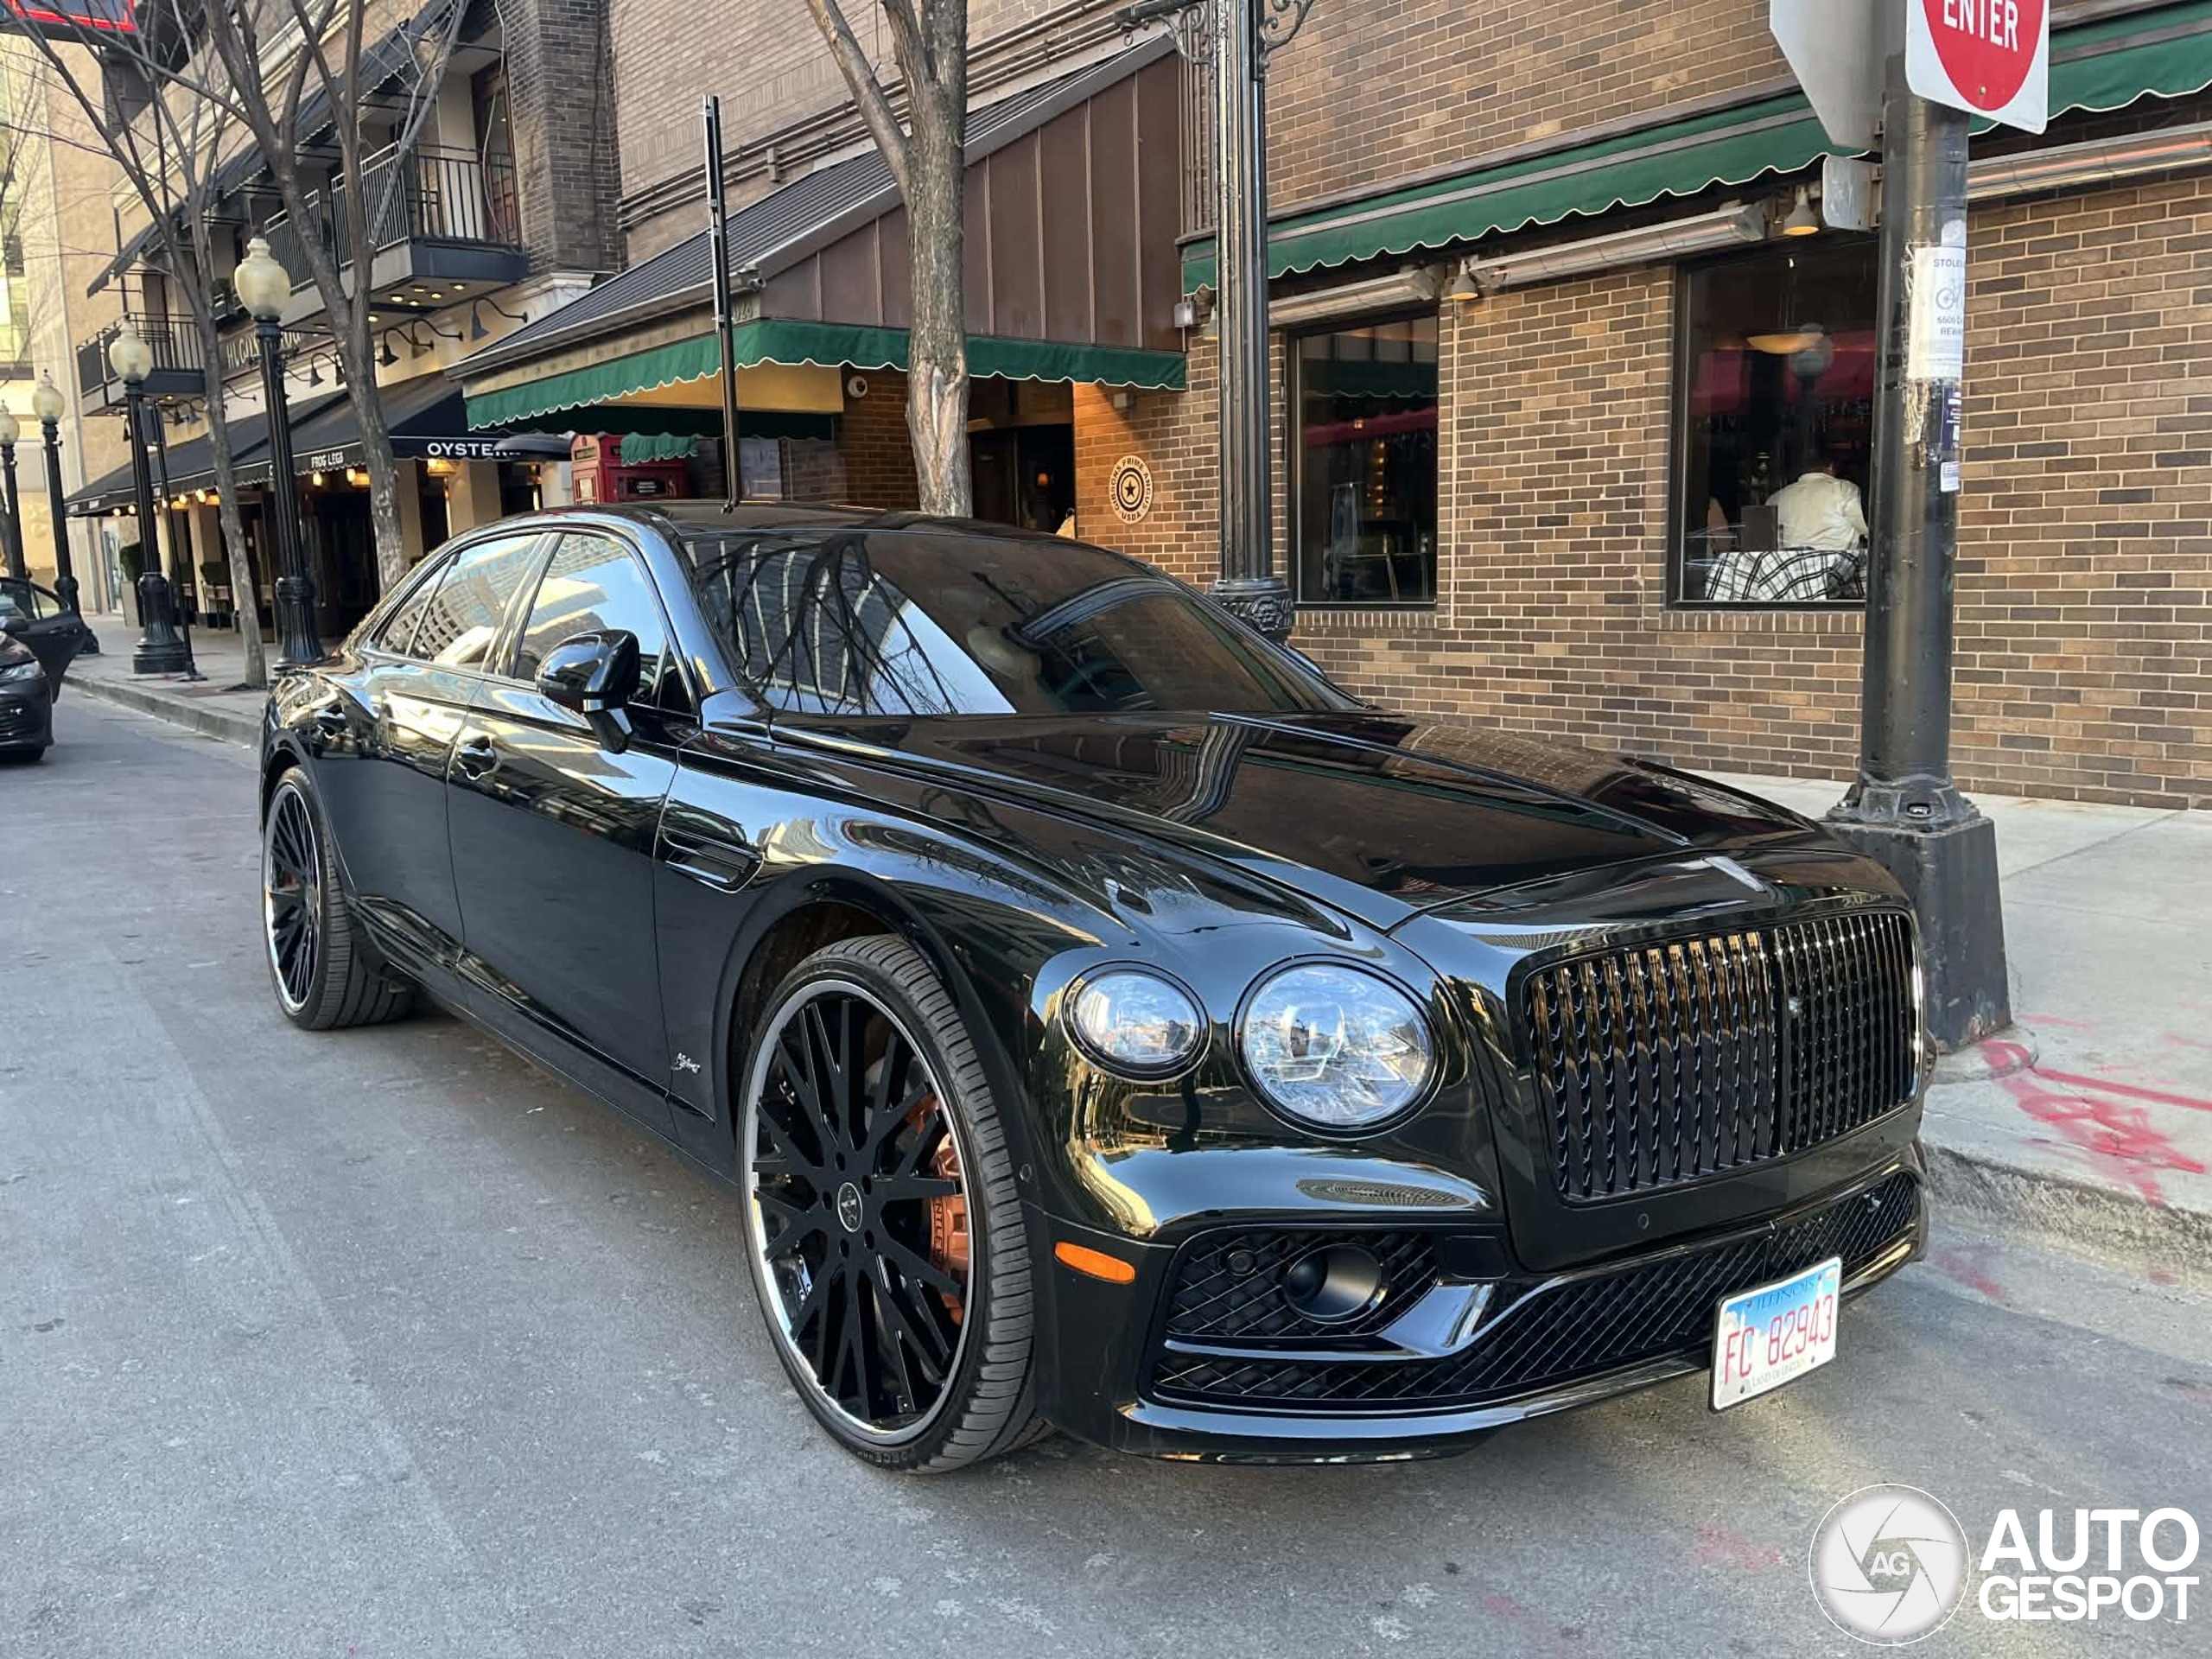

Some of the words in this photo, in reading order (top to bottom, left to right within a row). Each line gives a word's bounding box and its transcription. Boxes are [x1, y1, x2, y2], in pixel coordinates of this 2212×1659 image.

[1943, 0, 2018, 52] ENTER
[427, 442, 521, 456] OYSTE
[1122, 457, 1144, 470] PRIME
[1121, 512, 1141, 521] USDA
[1725, 1326, 1754, 1385] FC
[1768, 1294, 1834, 1366] 82943
